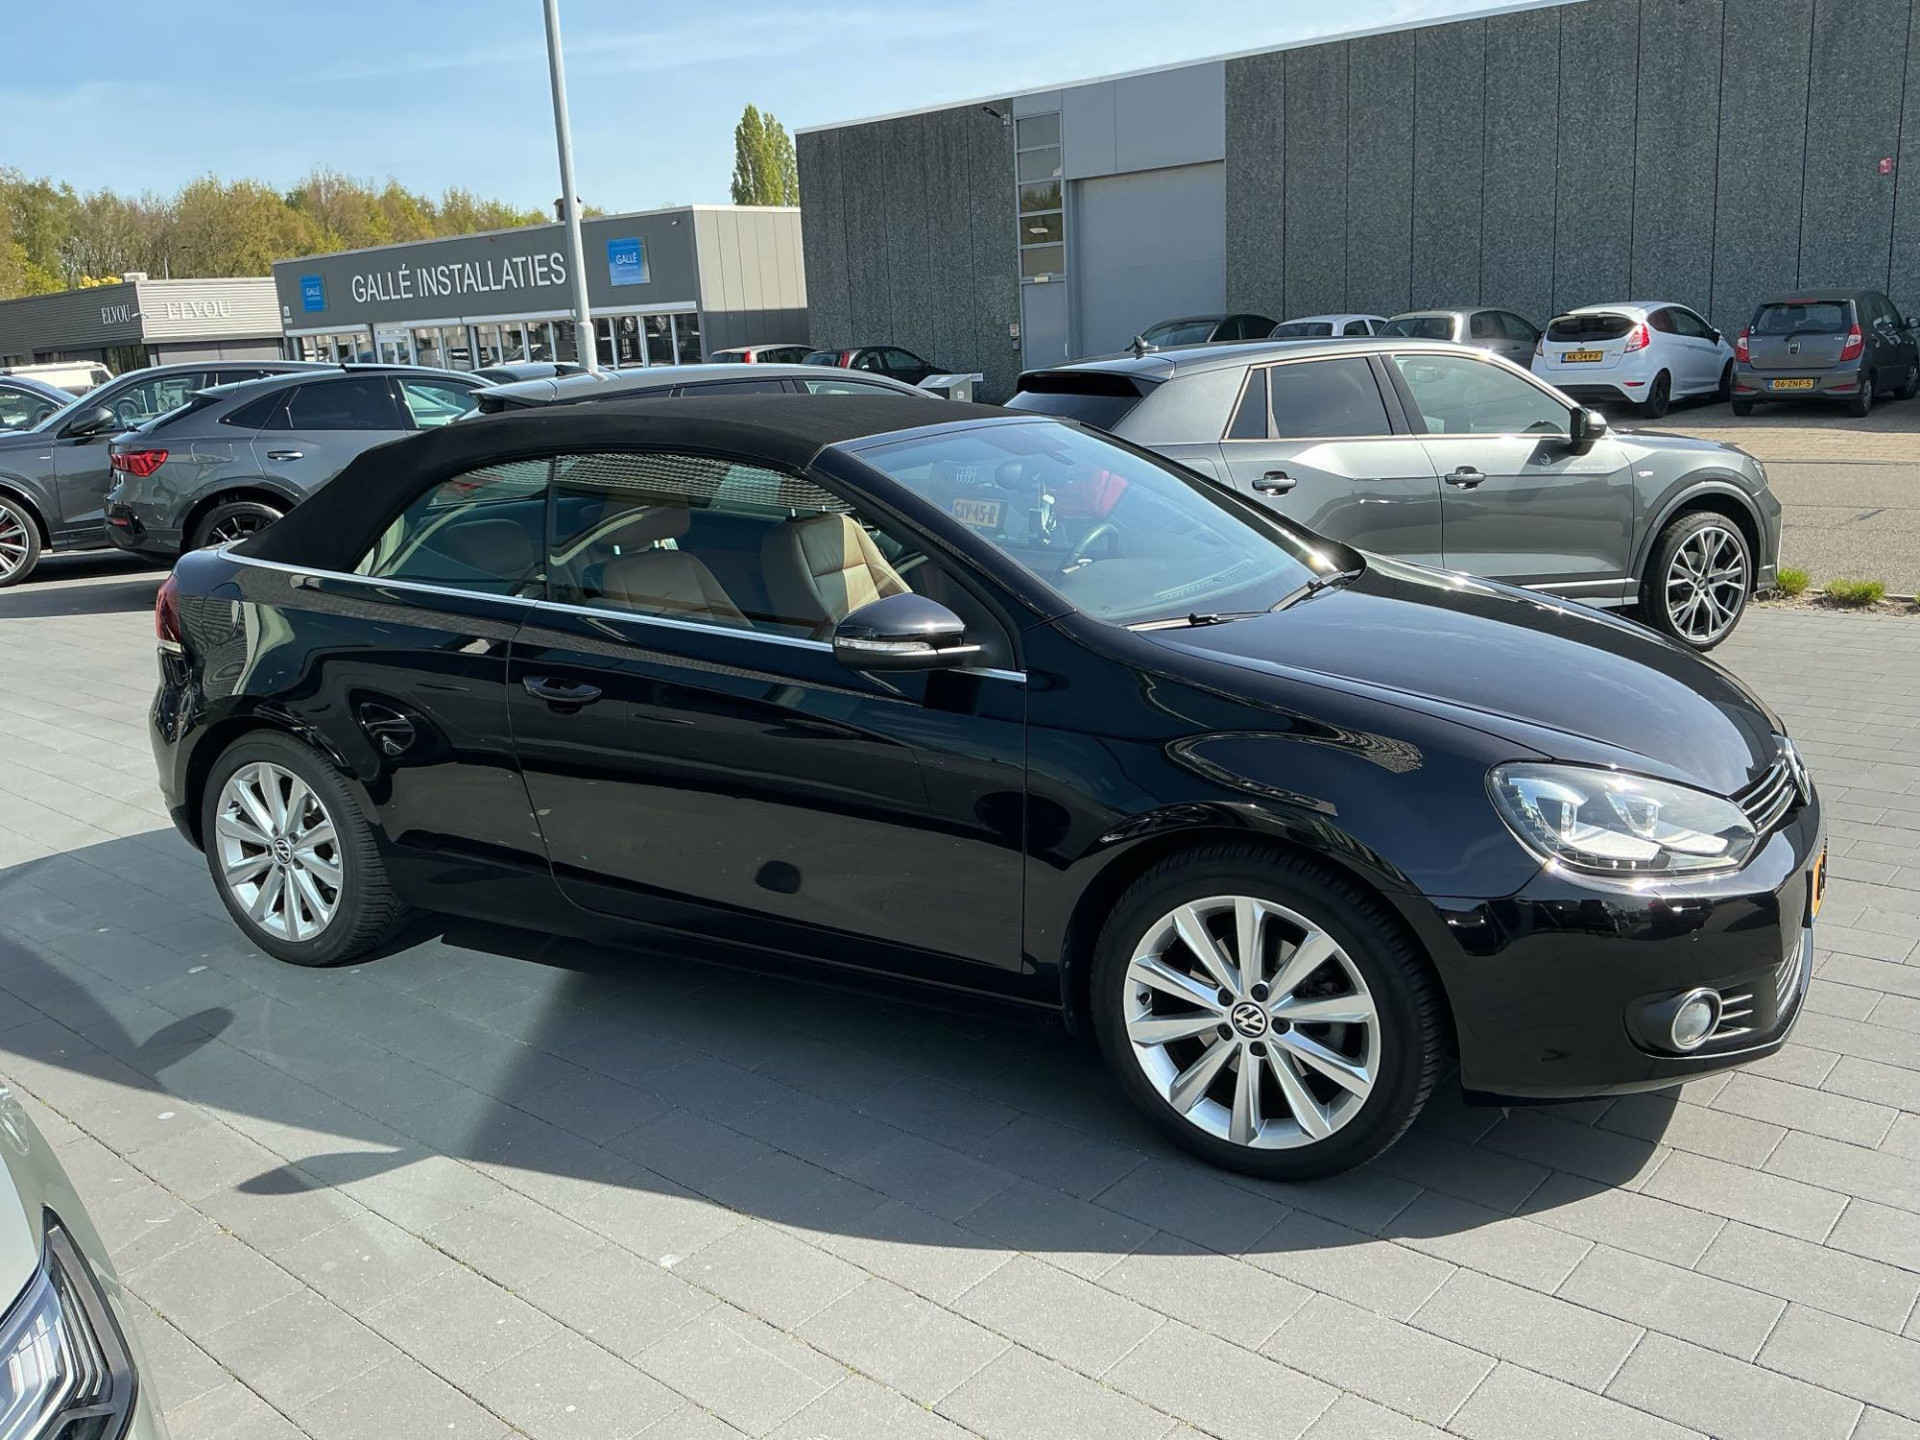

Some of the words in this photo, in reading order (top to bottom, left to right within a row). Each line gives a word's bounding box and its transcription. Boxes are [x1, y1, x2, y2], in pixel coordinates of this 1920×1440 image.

[615, 251, 638, 265] GALLÉ
[351, 263, 413, 303] GALLÉ
[416, 252, 567, 297] INSTALLATIES
[101, 305, 131, 324] ELVOU
[166, 300, 231, 320] ELVOU
